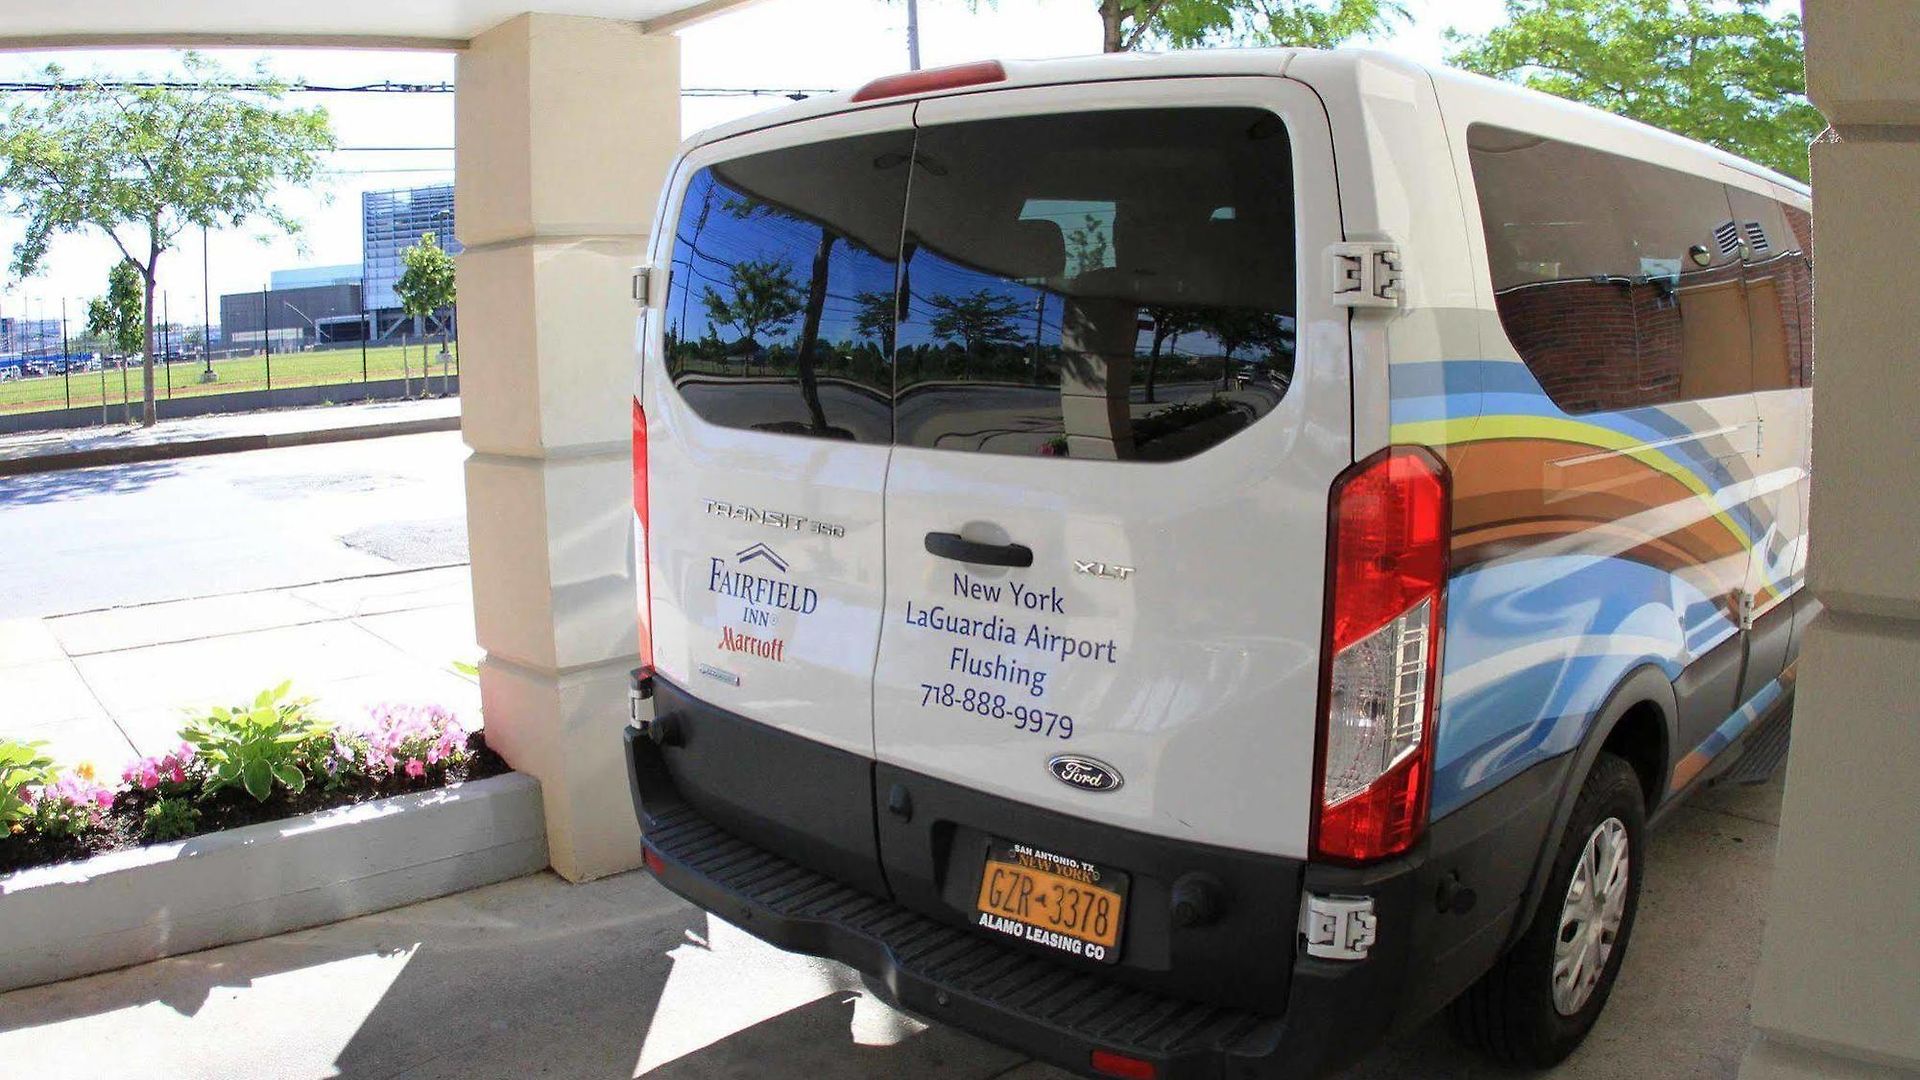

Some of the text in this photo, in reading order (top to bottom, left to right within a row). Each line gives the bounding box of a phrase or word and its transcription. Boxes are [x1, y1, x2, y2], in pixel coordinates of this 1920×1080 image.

[703, 498, 807, 531] TRANSIT
[1074, 560, 1136, 581] XLT
[953, 573, 1065, 614] New York
[743, 607, 770, 627] INN
[906, 601, 1117, 664] LaGuardia Airport
[718, 625, 785, 662] Marriott
[950, 647, 1047, 697] Flushing
[920, 683, 1074, 740] 718-888-9979
[1061, 762, 1103, 787] Ford
[1014, 844, 1033, 856] SAN
[1081, 862, 1095, 872] TX
[1019, 855, 1093, 883] NEW YORK
[989, 868, 1109, 937] GZR 3378
[979, 913, 1105, 961] ALAMO LEASING CO
